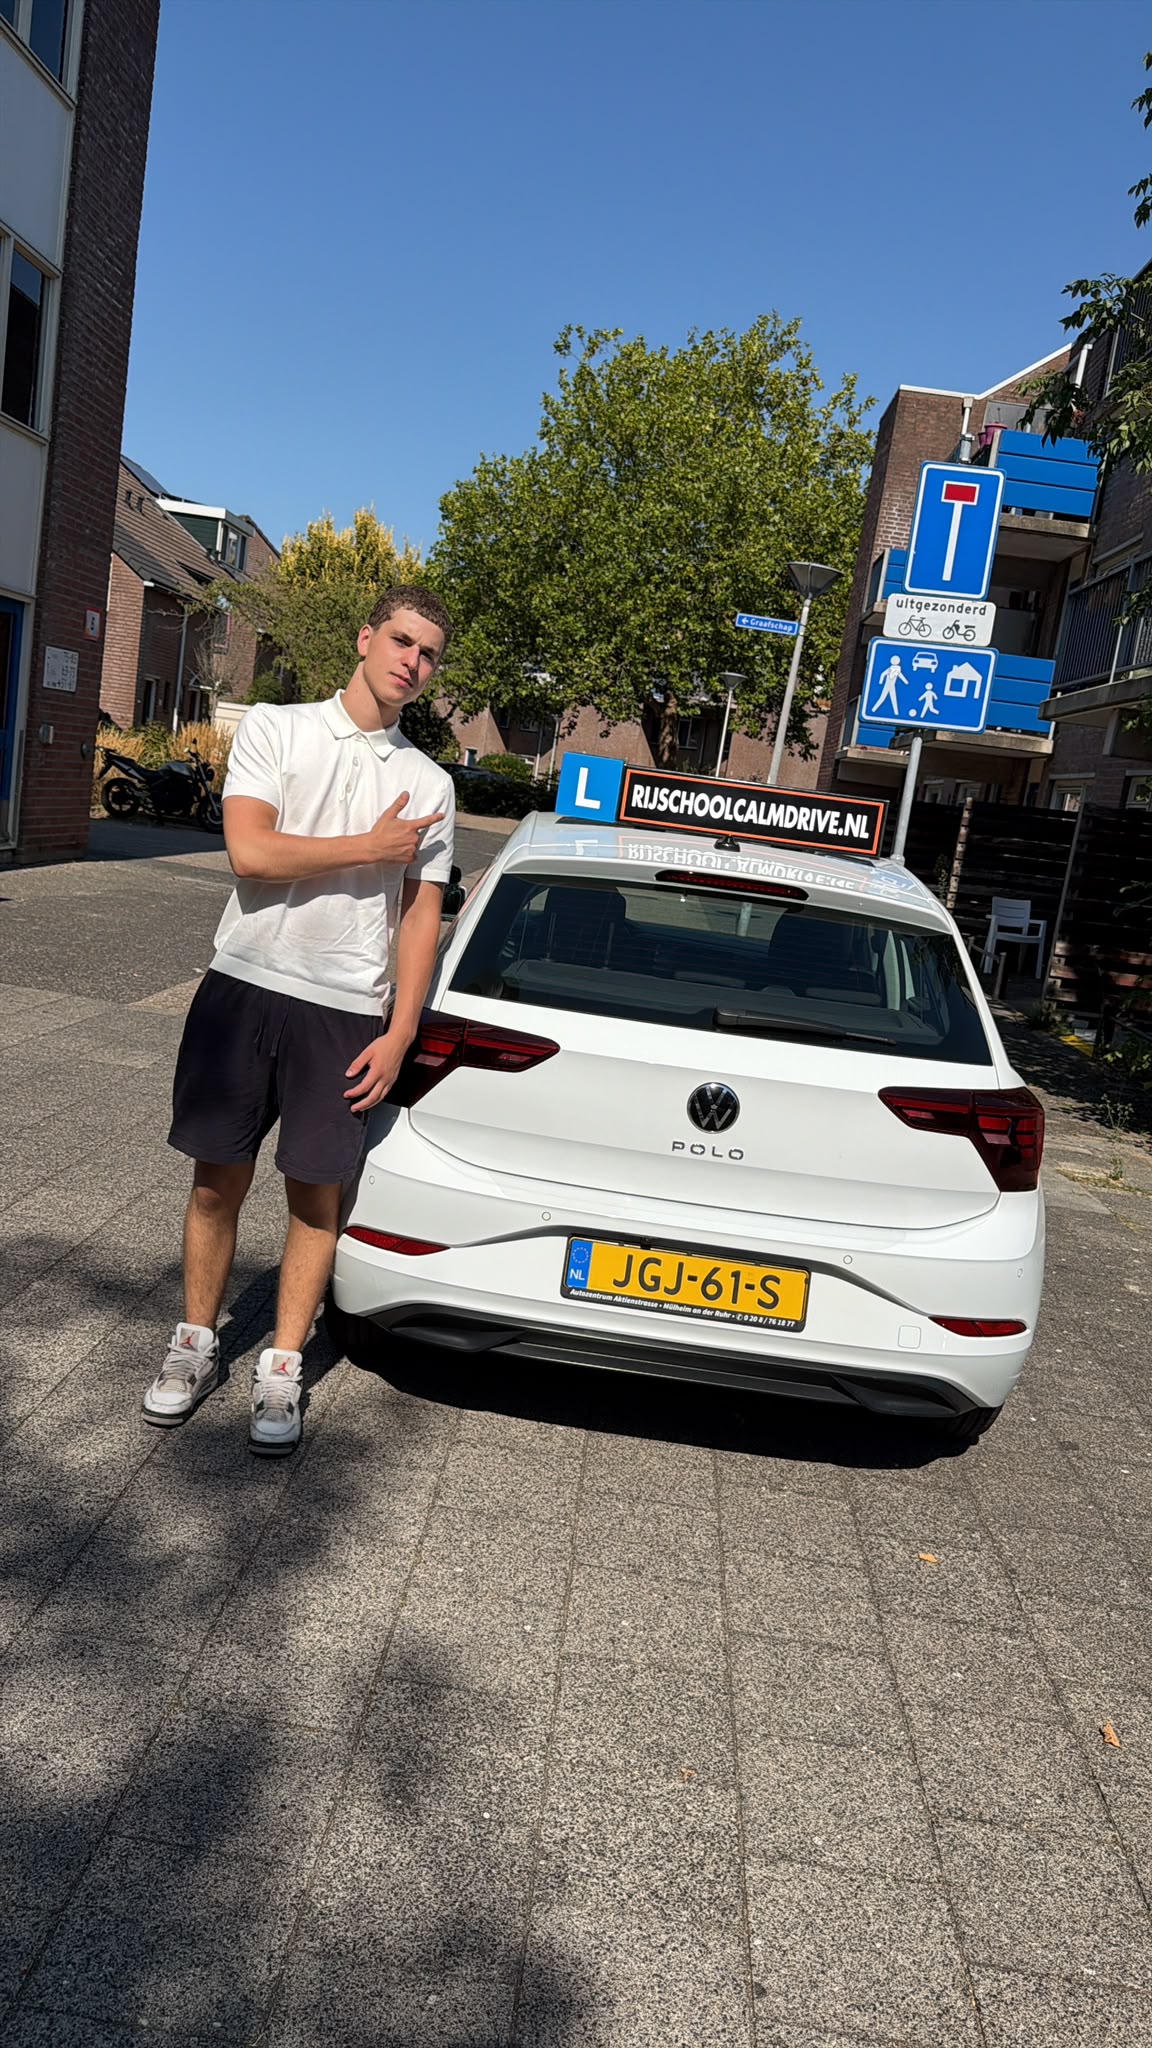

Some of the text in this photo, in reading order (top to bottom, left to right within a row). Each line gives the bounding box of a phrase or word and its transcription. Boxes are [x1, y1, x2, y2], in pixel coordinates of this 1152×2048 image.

[896, 598, 987, 616] uitgezonderd
[750, 618, 793, 633] Graafschap
[575, 767, 600, 810] L
[631, 784, 869, 839] RIJSCHOOLCALMDRIVE.NL
[672, 1141, 744, 1161] POLO
[569, 1268, 585, 1281] NL
[612, 1254, 781, 1310] JGJ-61-S
[570, 1288, 613, 1302] Autozentrum
[613, 1296, 659, 1309] Aktienstrasse
[663, 1302, 692, 1314] Mülheim
[702, 1308, 714, 1317] der
[715, 1310, 731, 1319] Ruhr
